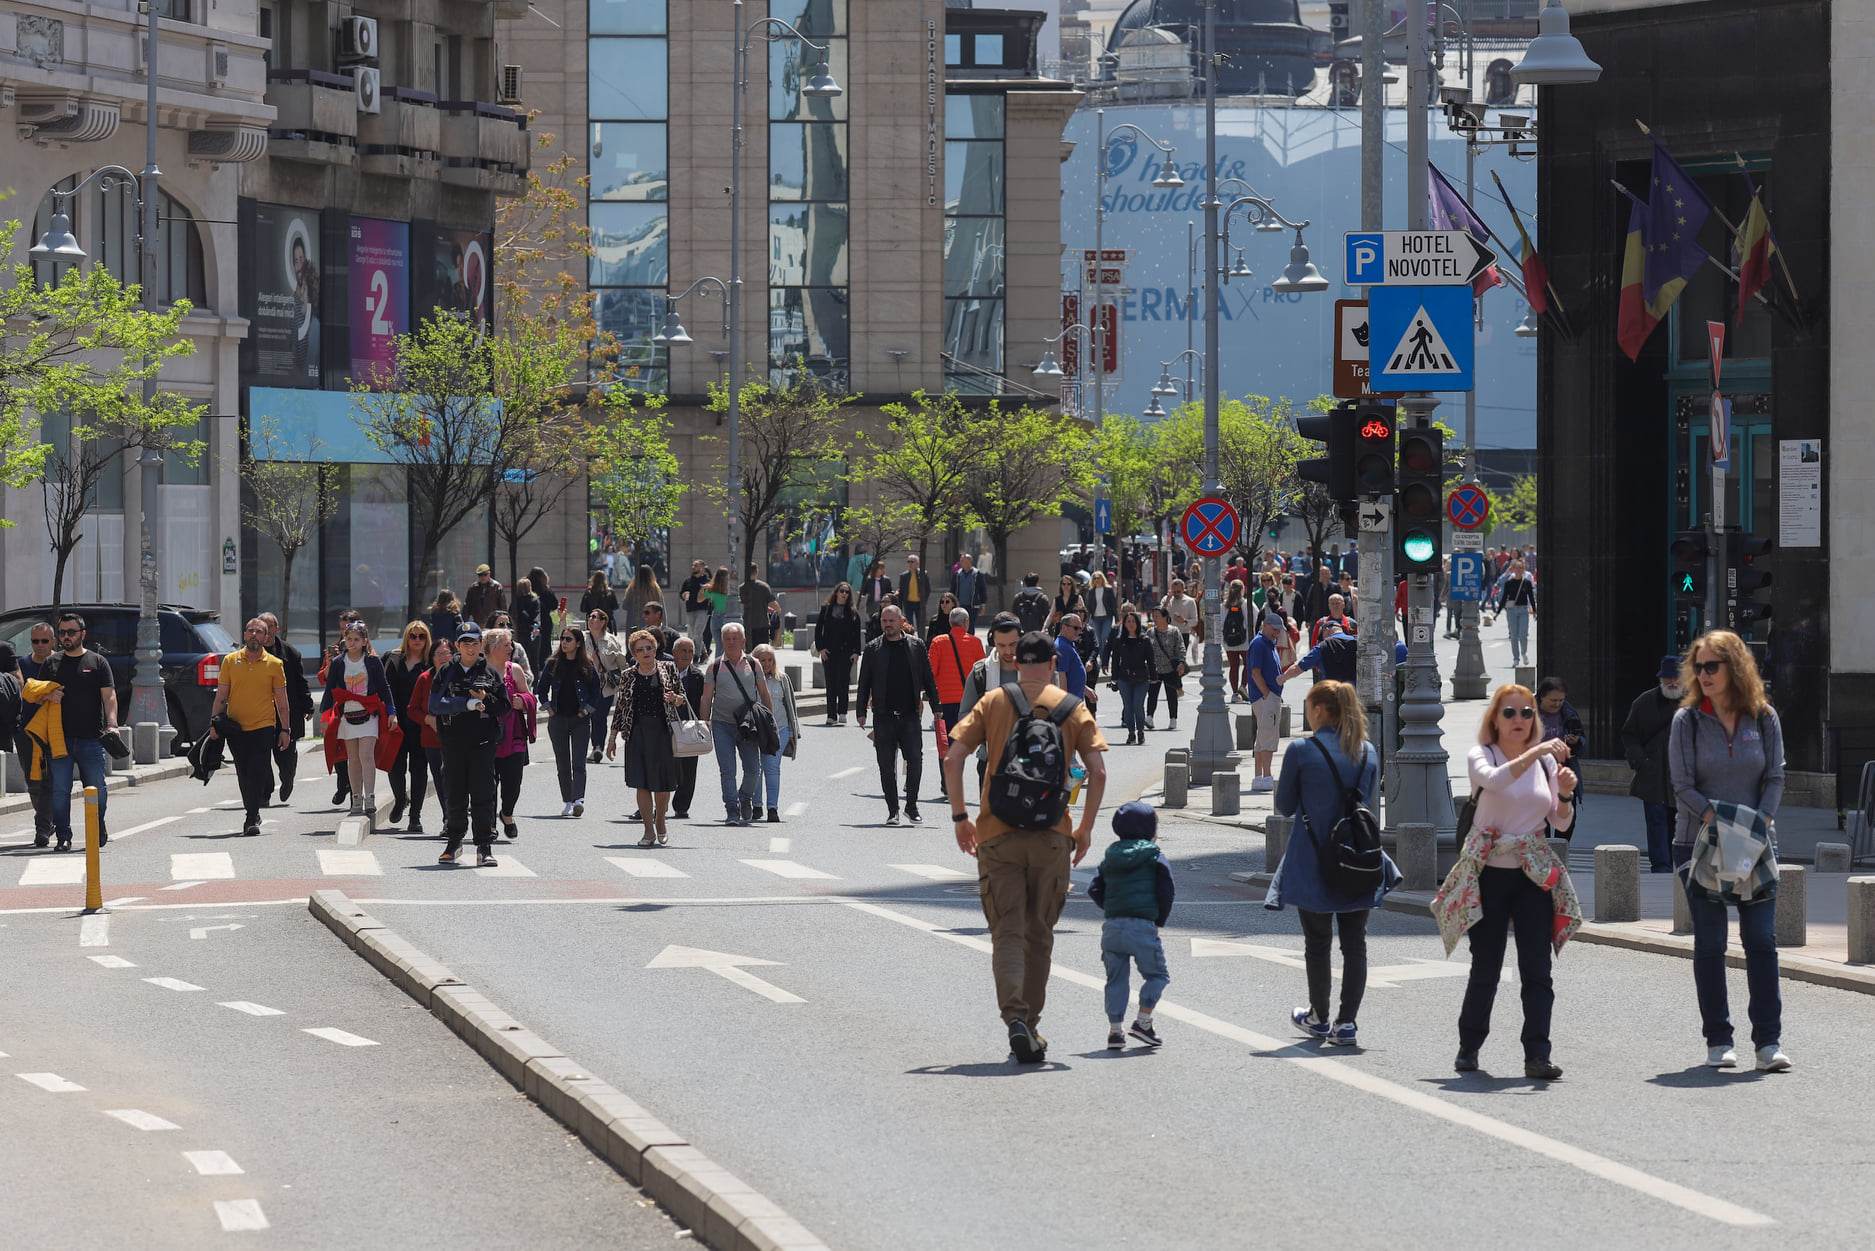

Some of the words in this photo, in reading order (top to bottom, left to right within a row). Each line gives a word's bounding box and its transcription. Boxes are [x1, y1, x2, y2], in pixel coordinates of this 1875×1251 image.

[927, 19, 936, 113] BUCHAREST
[927, 123, 936, 206] MAJESTIC
[1138, 153, 1229, 181] had
[1227, 160, 1246, 181] &
[1402, 235, 1454, 253] HOTEL
[1356, 247, 1376, 275] P
[1389, 258, 1461, 277] NOVOTEL
[1087, 270, 1120, 282] CPSA
[1113, 287, 1260, 321] ERMAX
[1457, 557, 1475, 586] P
